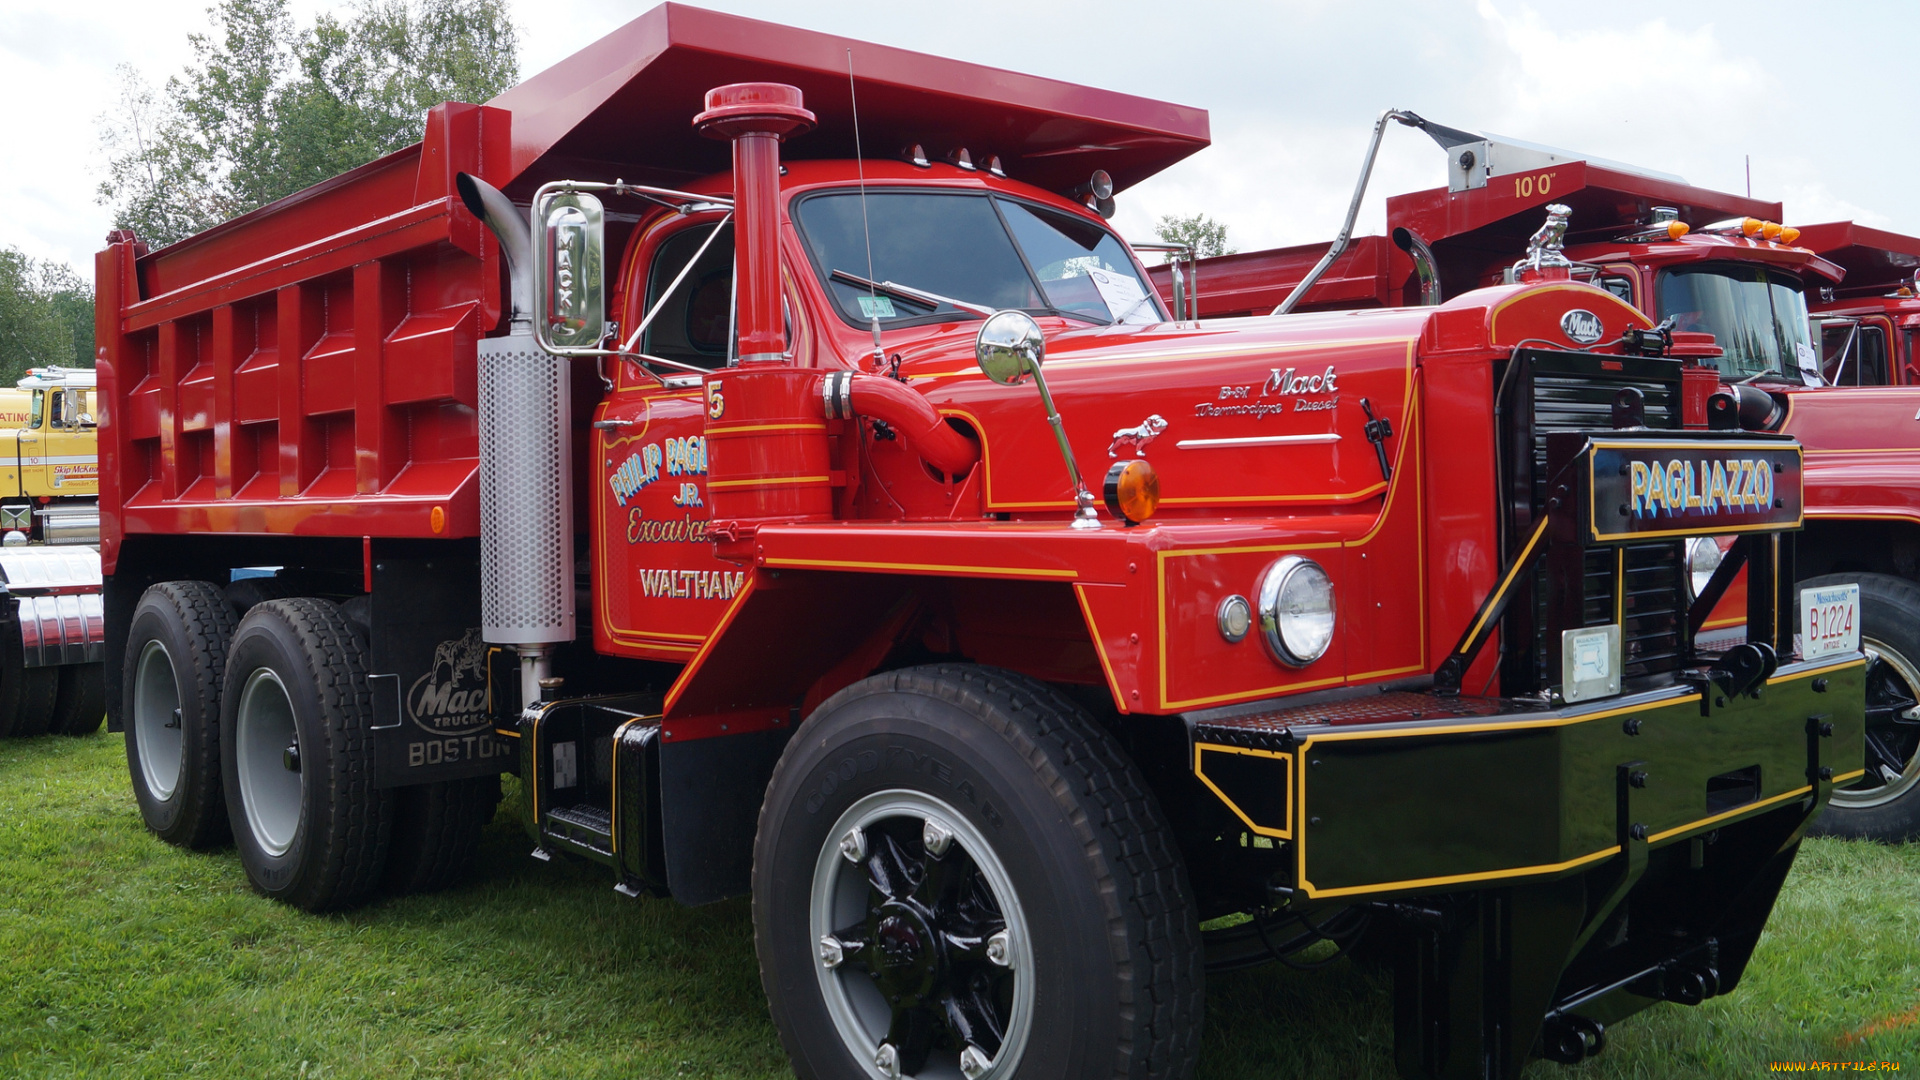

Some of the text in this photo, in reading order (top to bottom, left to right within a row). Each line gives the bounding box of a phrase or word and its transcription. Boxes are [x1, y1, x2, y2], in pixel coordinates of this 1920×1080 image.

[557, 230, 575, 310] MACK
[1568, 313, 1599, 339] Mack
[1259, 365, 1339, 397] Mack
[707, 380, 725, 420] 5
[1194, 396, 1339, 420] Thermodyne Diesel
[53, 465, 71, 475] Skip
[609, 442, 663, 507] PHILIP
[672, 483, 704, 507] JR.
[1631, 459, 1774, 518] PAGLIAZZO
[433, 714, 488, 728] TRUCKS
